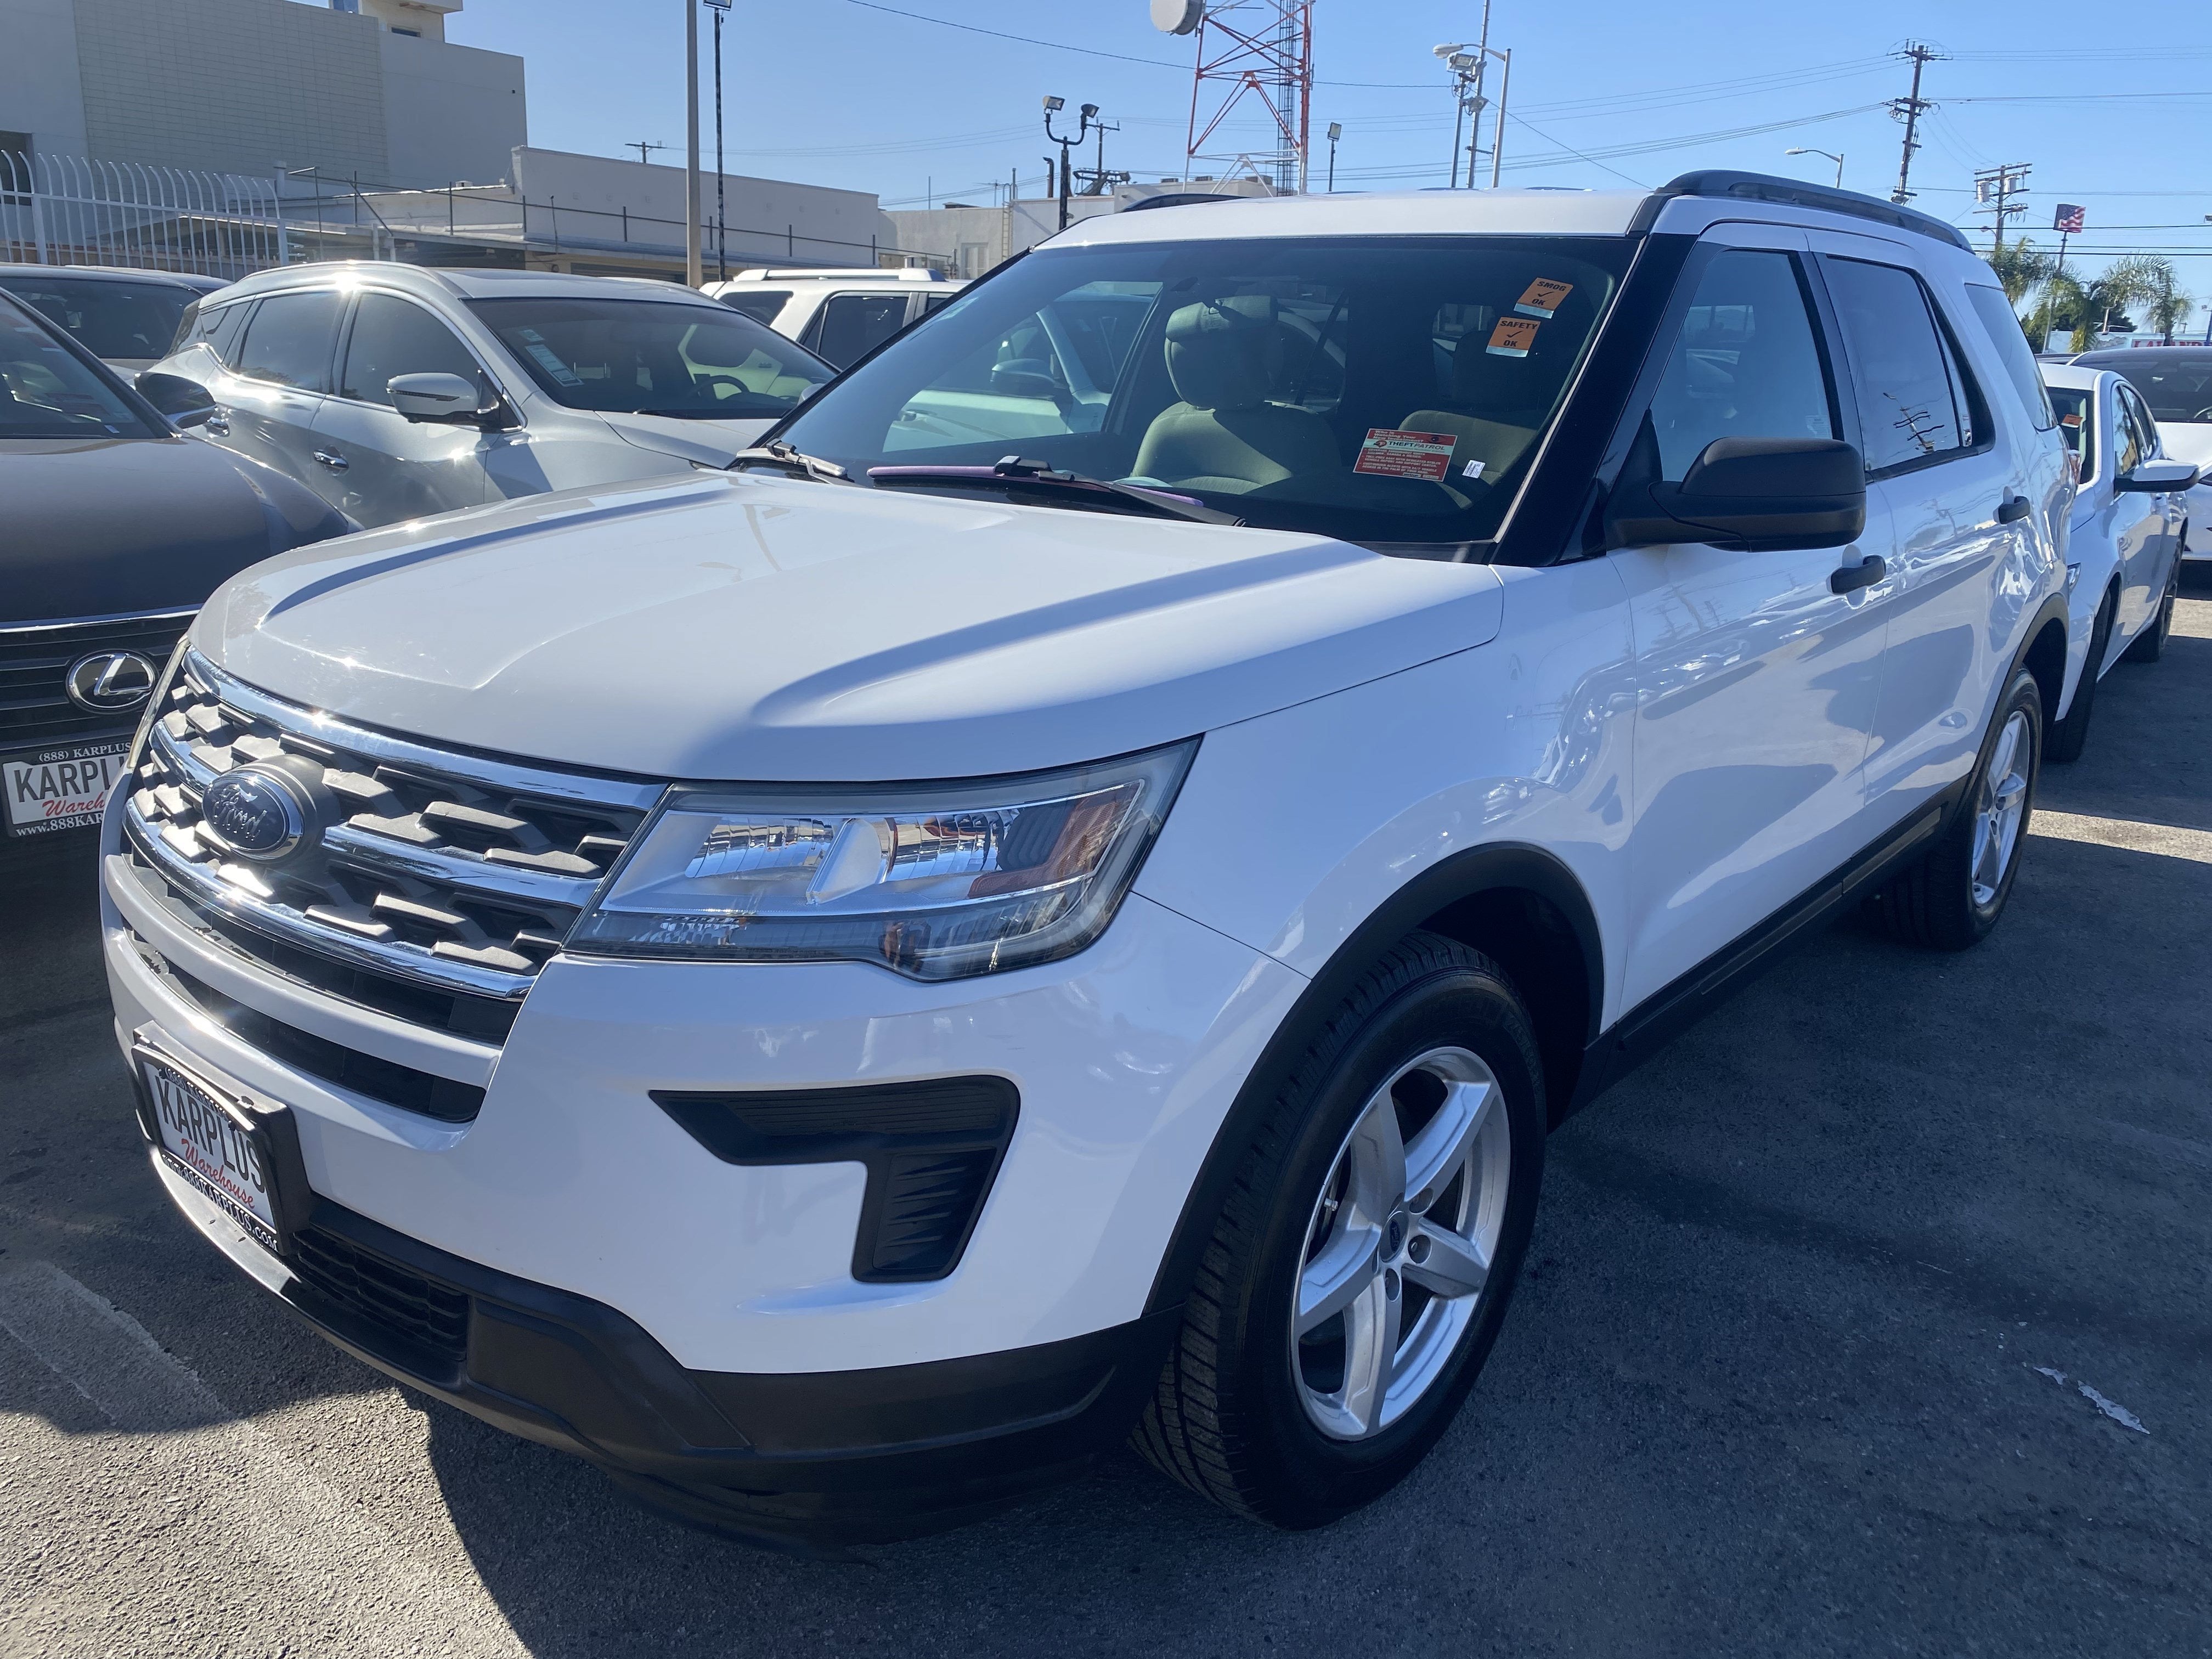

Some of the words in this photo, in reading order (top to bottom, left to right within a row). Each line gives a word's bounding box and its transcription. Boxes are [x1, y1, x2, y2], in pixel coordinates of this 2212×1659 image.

[1537, 280, 1567, 292] SMOG
[1531, 298, 1545, 306] OK
[1500, 320, 1538, 329] SAFETY
[1389, 441, 1445, 450] THEFTPATROL
[38, 750, 69, 763] (888)
[72, 742, 132, 758] KARPLUS
[155, 1075, 265, 1194] KARPLUS
[181, 1138, 255, 1209] Warehouse
